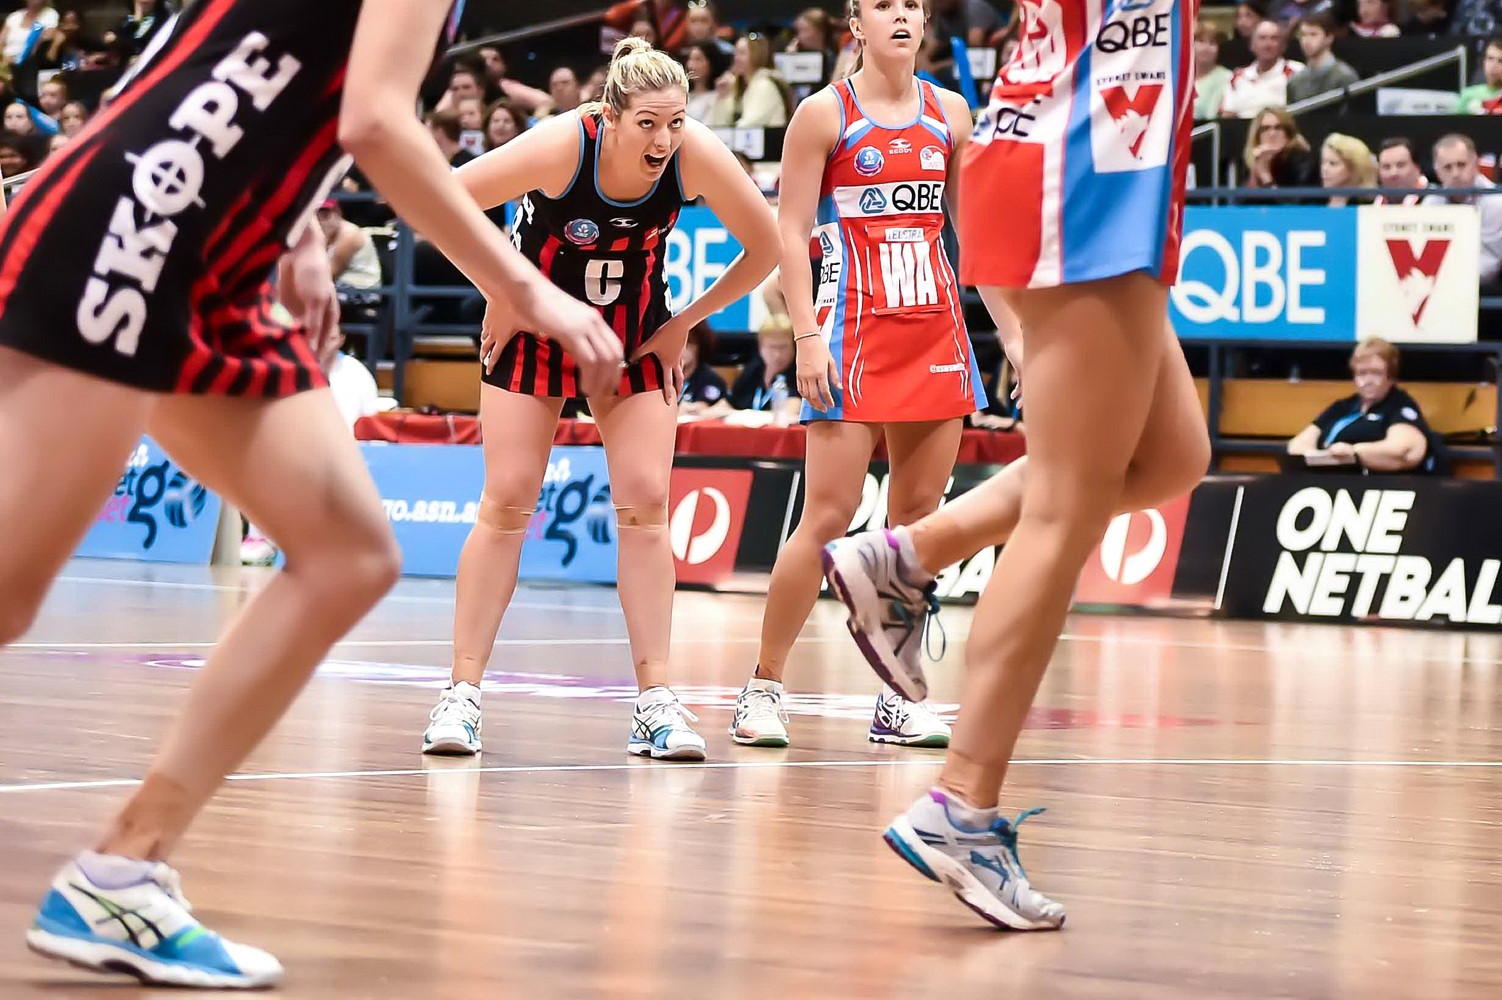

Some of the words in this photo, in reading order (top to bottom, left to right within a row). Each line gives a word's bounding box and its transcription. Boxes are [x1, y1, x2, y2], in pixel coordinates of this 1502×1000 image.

[1095, 13, 1169, 53] QBE
[76, 31, 301, 356] SKOPE
[892, 184, 942, 211] QBE
[585, 259, 624, 306] C
[665, 227, 729, 317] BE
[879, 241, 939, 308] WA
[1170, 229, 1326, 325] QBE
[1275, 486, 1417, 554] ONE
